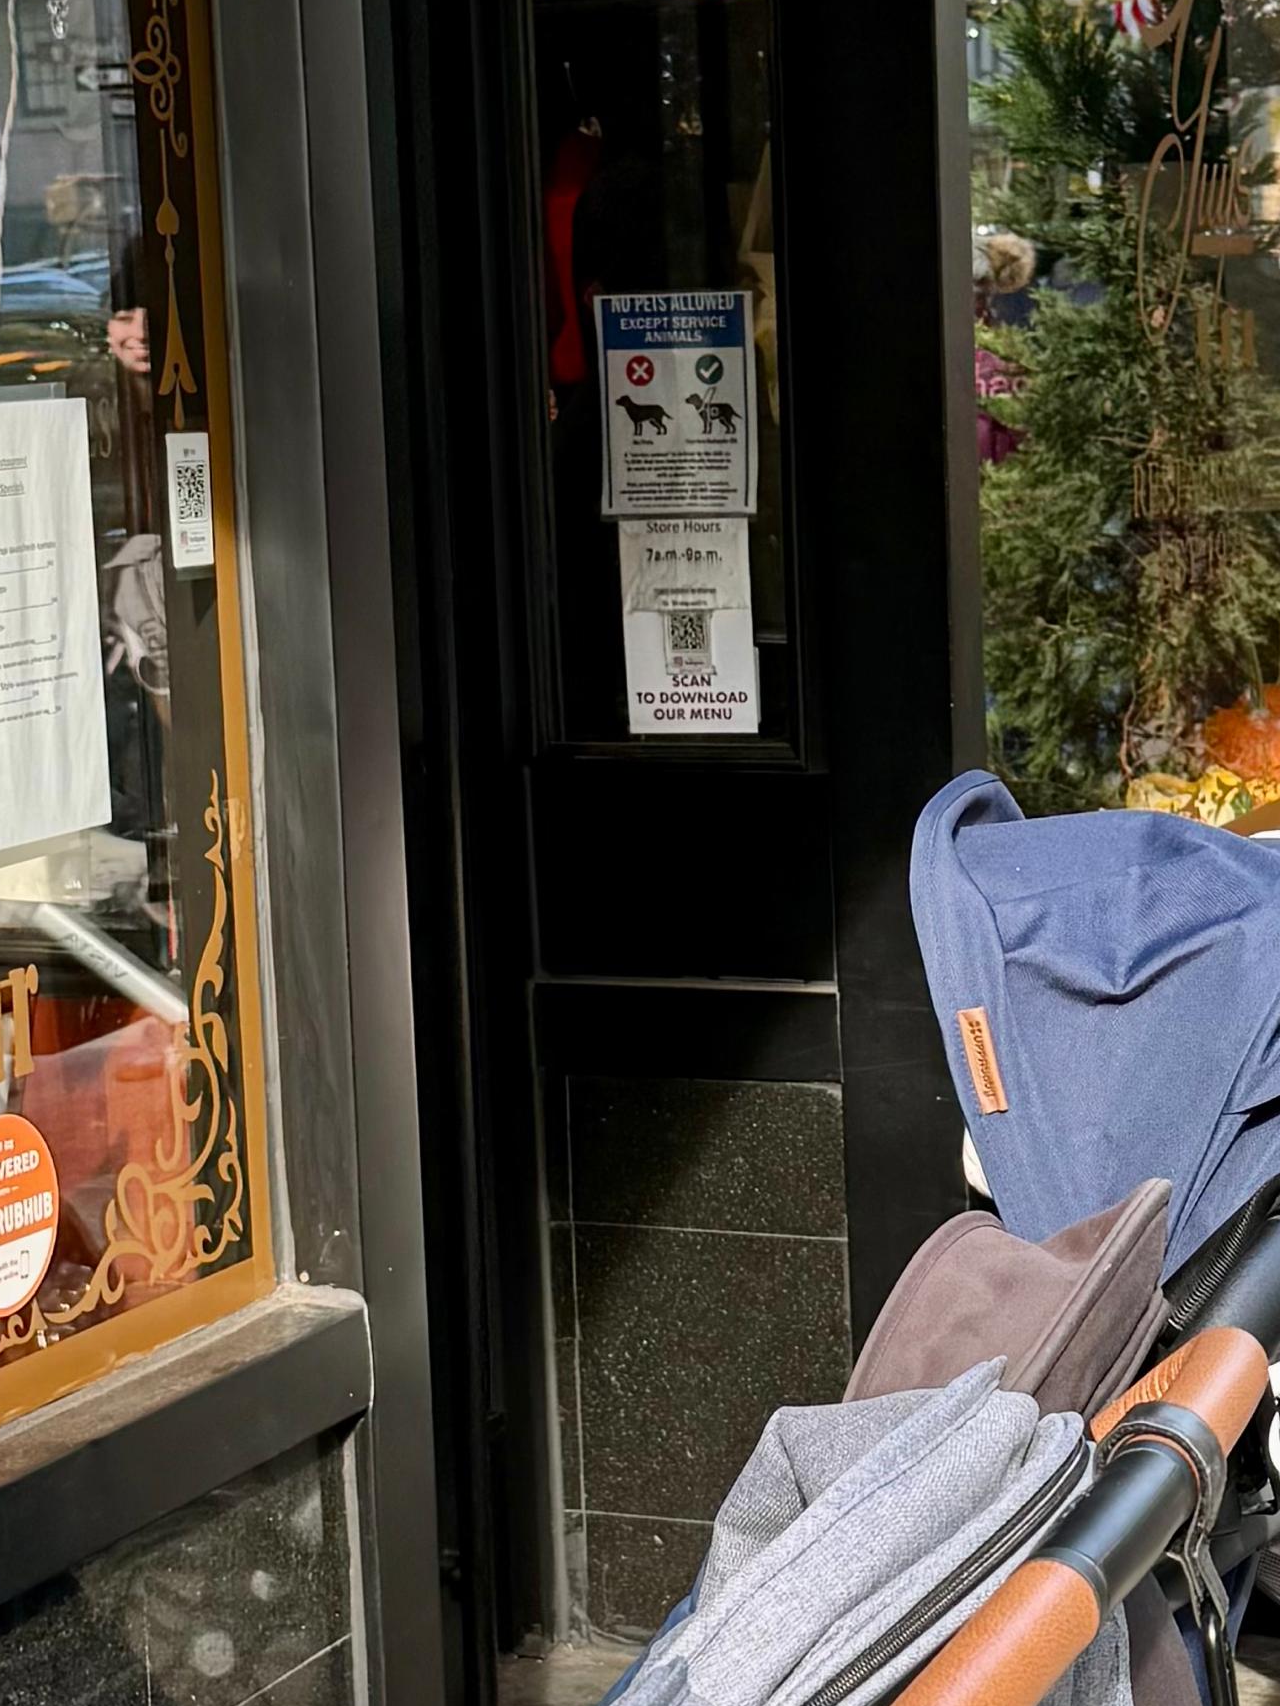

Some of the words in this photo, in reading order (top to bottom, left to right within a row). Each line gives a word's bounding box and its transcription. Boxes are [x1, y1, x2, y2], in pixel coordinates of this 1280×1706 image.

[611, 296, 631, 313] NO
[634, 295, 668, 312] PETS
[671, 293, 734, 311] ALLOWED
[620, 317, 668, 330] EXCEPT
[672, 315, 727, 328] SERVICE
[645, 330, 703, 343] ANIMALS
[646, 521, 680, 534] Store
[683, 520, 721, 534] Hours
[671, 674, 711, 687] SCAN
[636, 691, 656, 704] TO
[660, 691, 748, 704] DOWNLOAD
[653, 708, 686, 721] OUR
[690, 707, 732, 720] MENU
